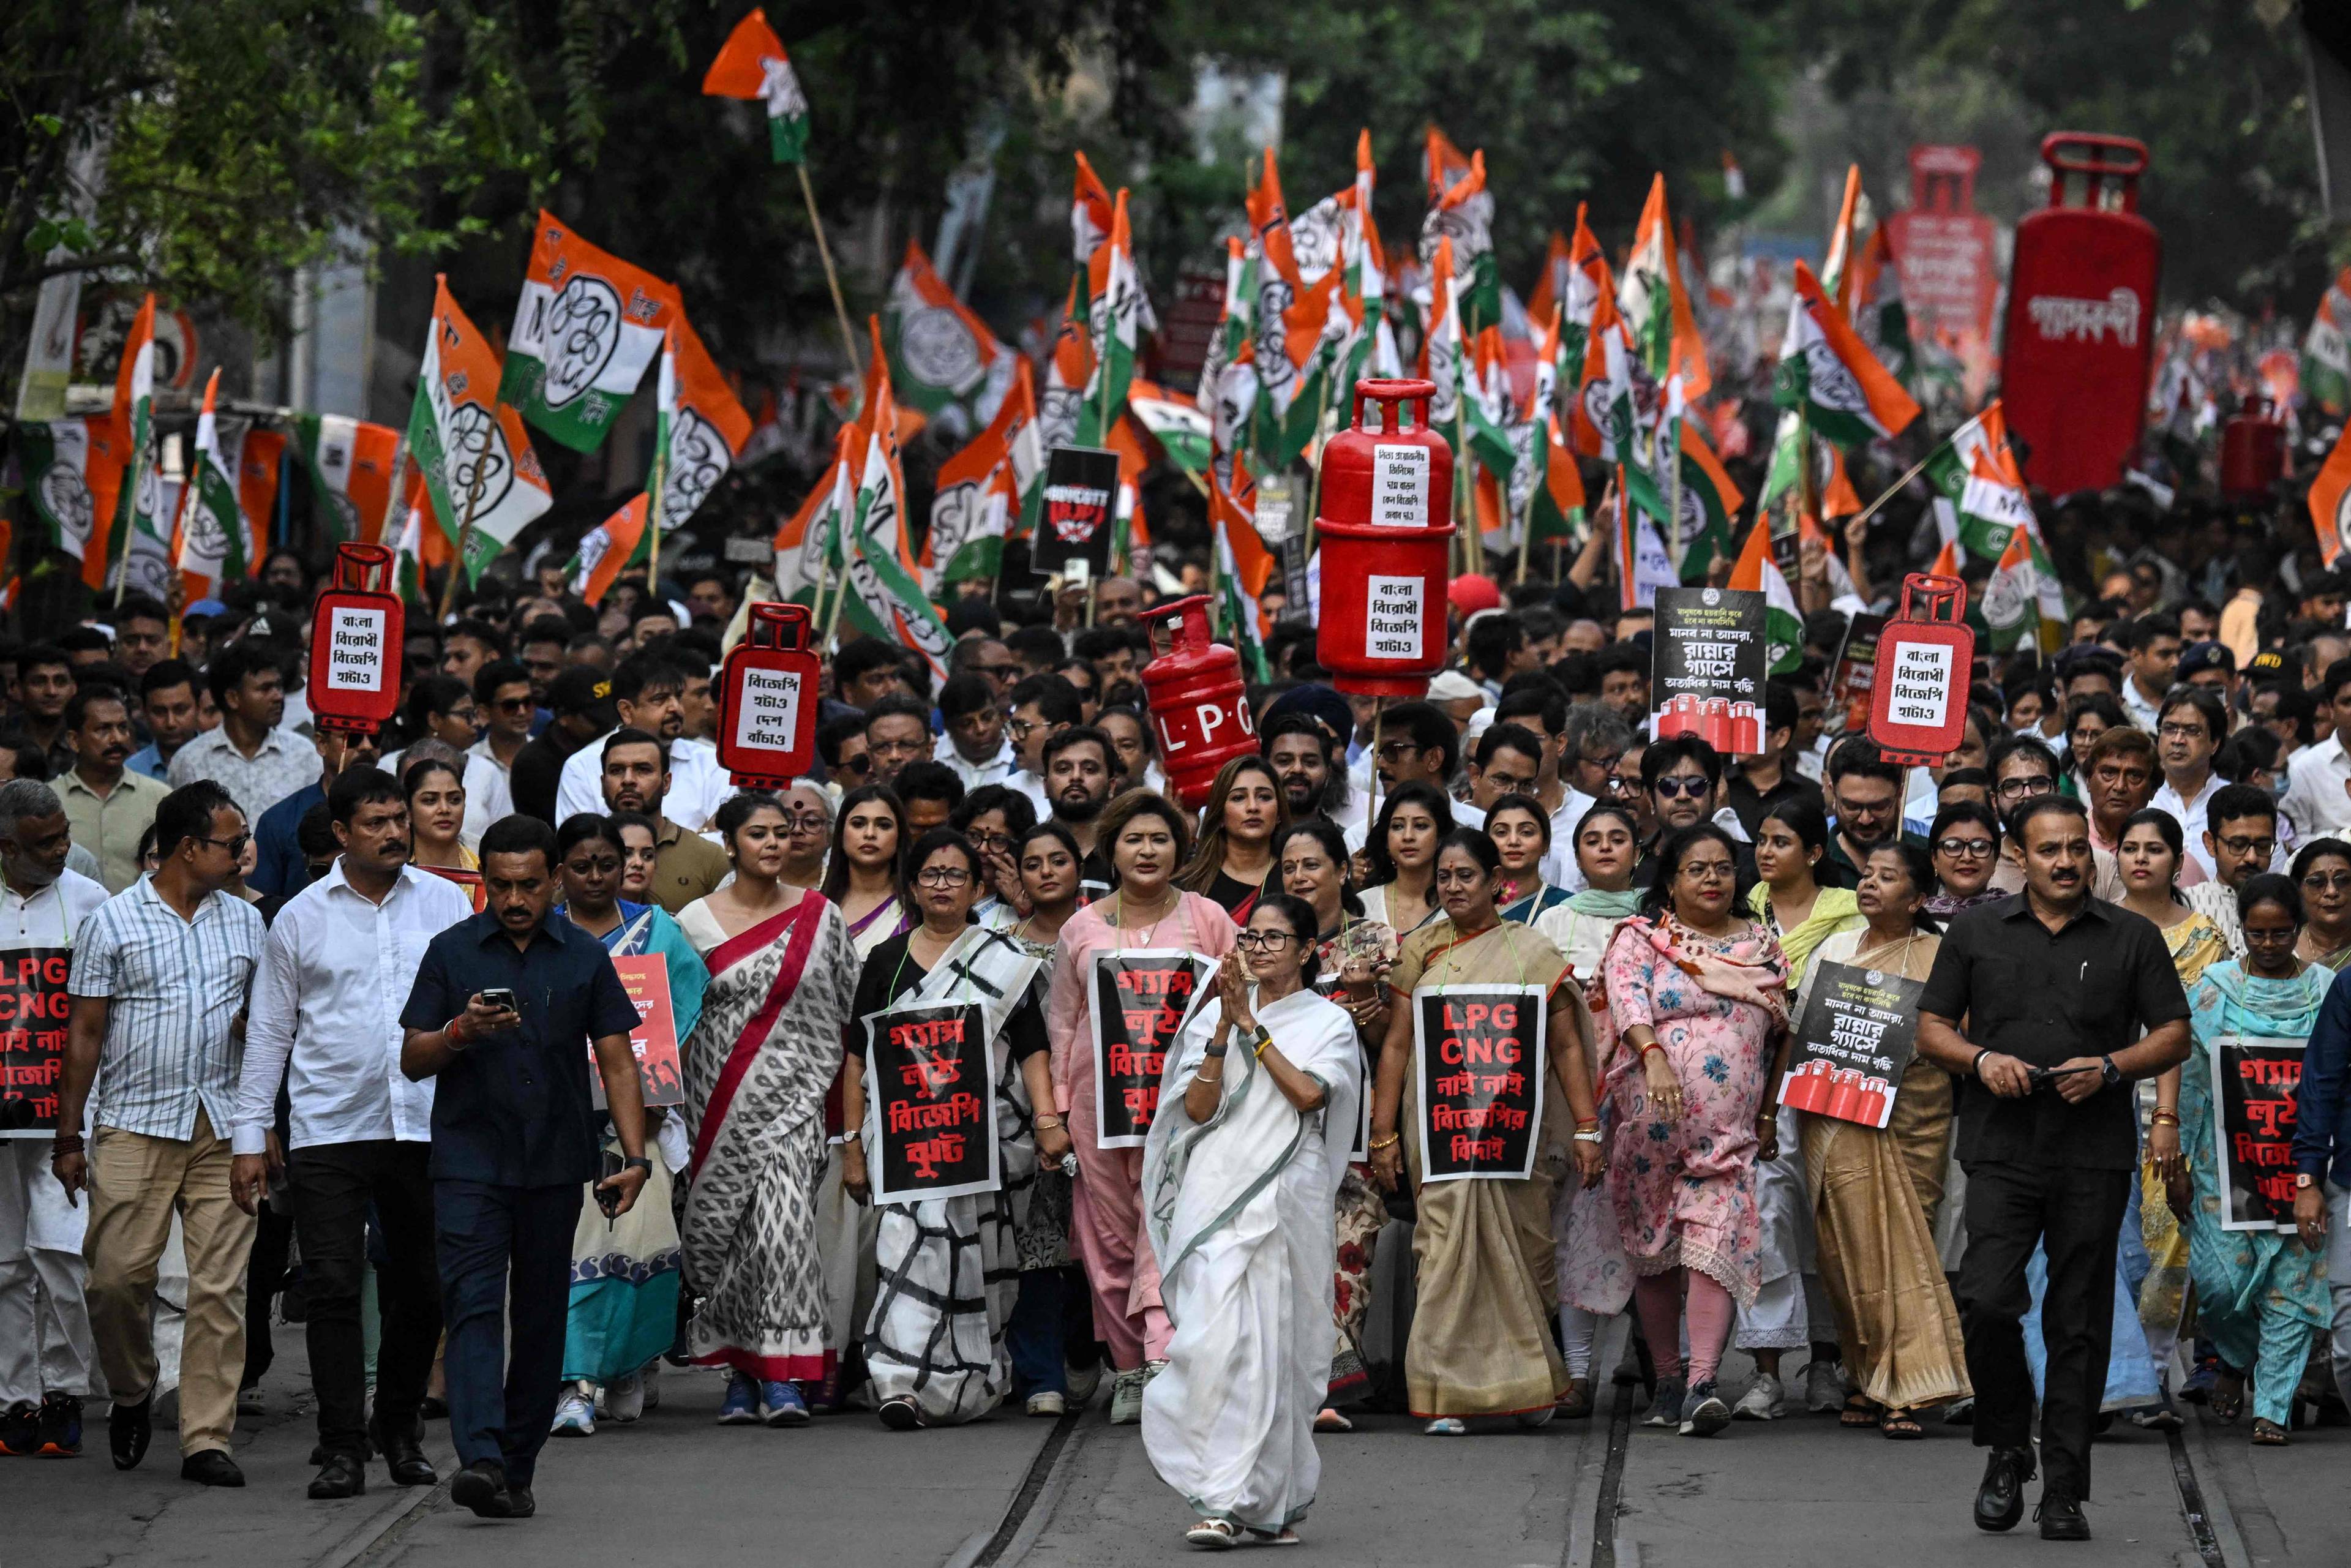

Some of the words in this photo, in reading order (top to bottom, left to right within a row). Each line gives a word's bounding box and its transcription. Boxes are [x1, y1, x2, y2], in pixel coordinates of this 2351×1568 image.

[1379, 584, 1412, 596] বাংলা
[1373, 599, 1417, 615] বিরোধী
[343, 617, 372, 628] বাংলা
[1371, 618, 1418, 634] বিজেপি
[336, 631, 377, 647] বিরোধী
[1669, 628, 1698, 638] মানব
[1700, 629, 1713, 639] না
[1715, 630, 1753, 643] আমরা,
[1374, 637, 1412, 652] হাটাও
[1682, 642, 1738, 661] রান্নার
[333, 650, 377, 666] বিজেপি
[1907, 650, 1939, 664] বাংলা
[1684, 659, 1736, 677] গ্যাসে
[1899, 666, 1944, 683] বিরোধী
[337, 670, 370, 684] হাটাও
[748, 674, 798, 691] বিজেপি
[1664, 675, 1708, 689] অত্যধিক
[1711, 679, 1731, 690] দাম
[1733, 677, 1755, 693] বৃদ্ধি
[1895, 685, 1943, 701] বিজেপি
[754, 695, 787, 709] হটাও
[1898, 703, 1934, 719] হাটাও
[756, 715, 782, 727] দেশ
[748, 729, 785, 746] বাঁচাও
[1116, 969, 1193, 996] গ্যাস
[1442, 1003, 1518, 1031] LPG
[1824, 998, 1852, 1011] মানব
[1854, 1005, 1866, 1015] না
[1869, 1008, 1904, 1027] আমরা,
[889, 1018, 965, 1049] গ্যাস
[1834, 1012, 1887, 1039] রান্নার
[1830, 1028, 1880, 1054] গ্যাসে
[1441, 1037, 1522, 1065] CNG
[1807, 1041, 1849, 1059] অত্যধিক
[1851, 1051, 1870, 1065] দাম
[1872, 1056, 1894, 1072] বৃদ্ধি
[1436, 1070, 1478, 1097] নাই
[1481, 1070, 1525, 1097] নাই
[888, 1092, 981, 1134] বিজেপি
[1431, 1101, 1529, 1132] বিজেপির
[1450, 1135, 1507, 1163] বিদাই
